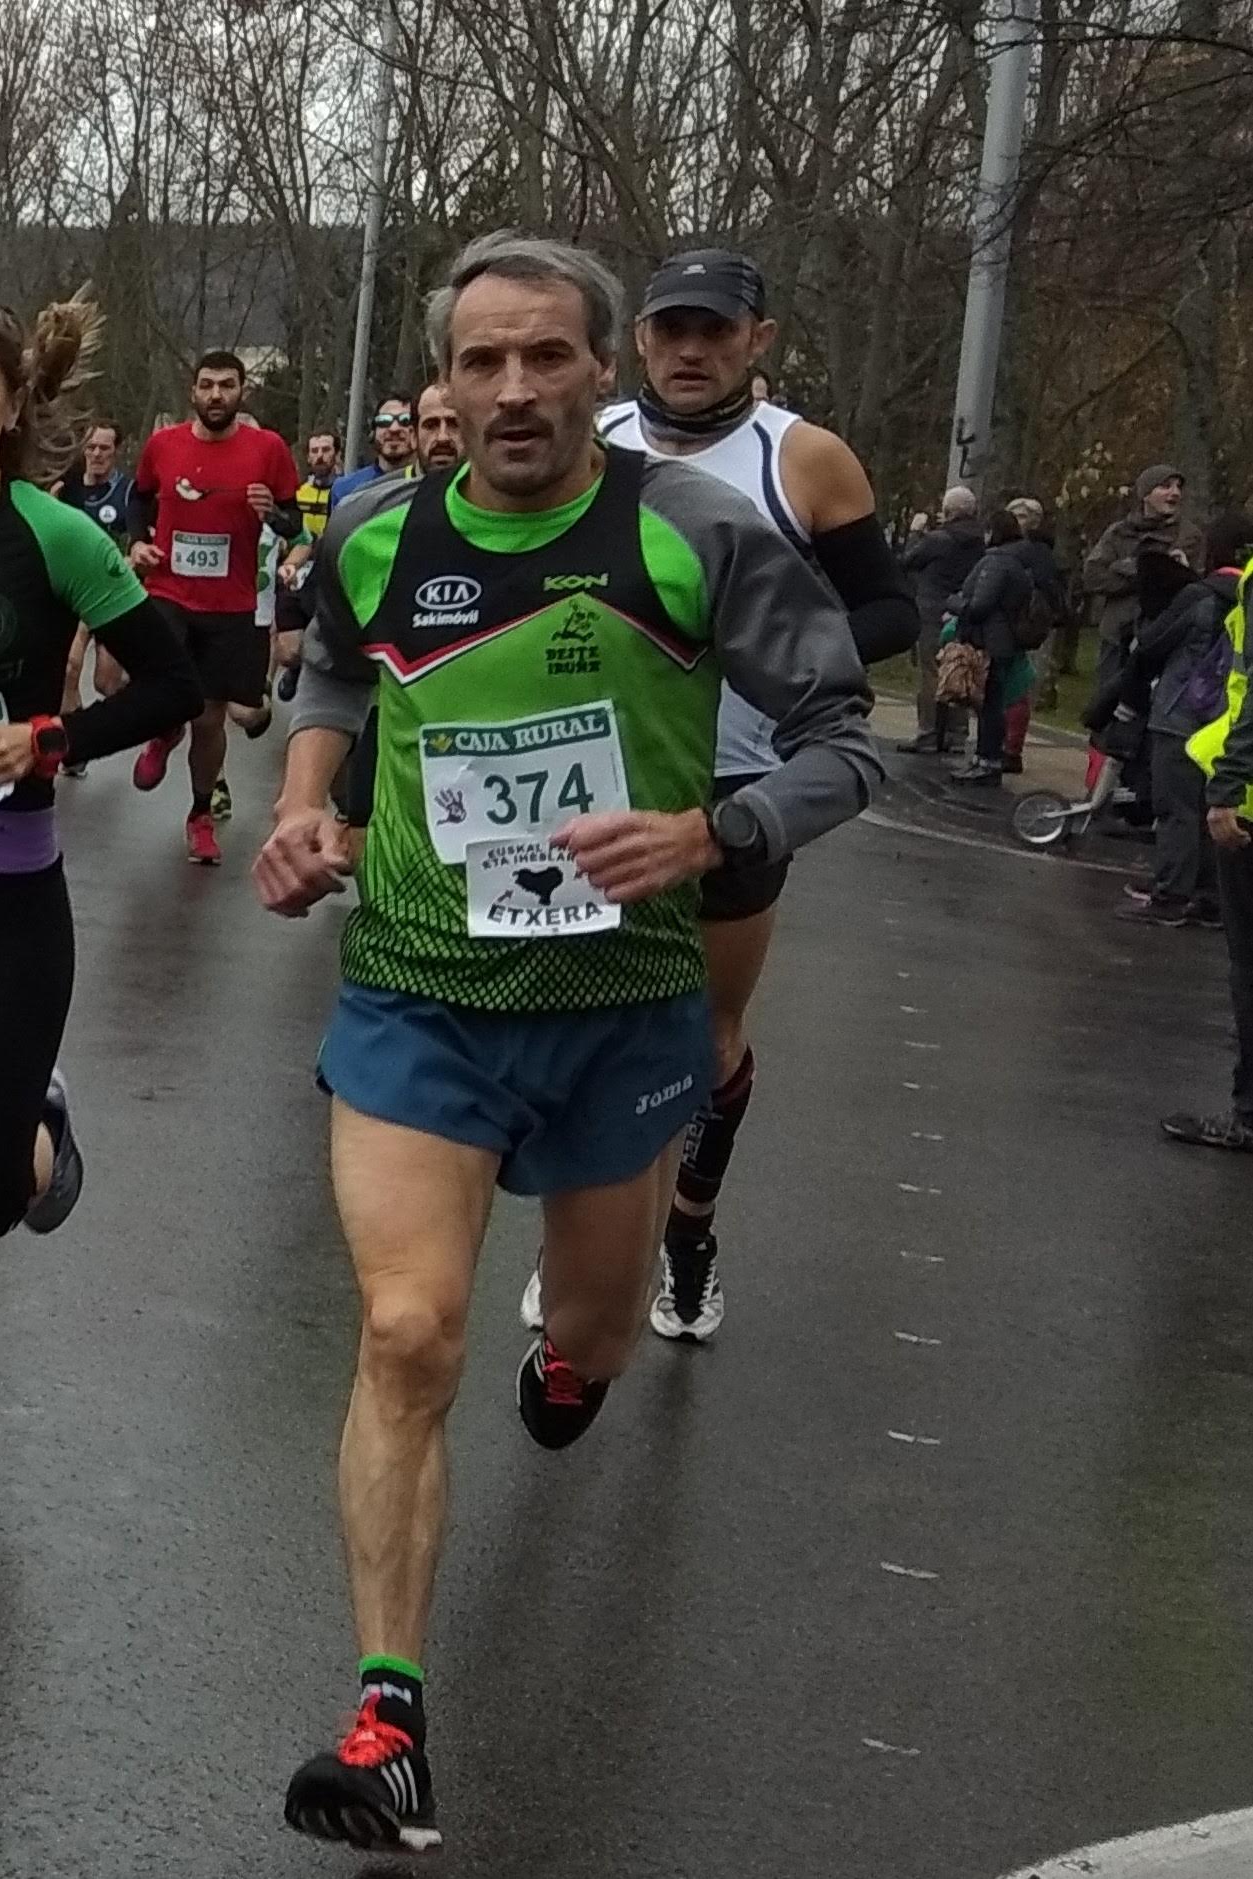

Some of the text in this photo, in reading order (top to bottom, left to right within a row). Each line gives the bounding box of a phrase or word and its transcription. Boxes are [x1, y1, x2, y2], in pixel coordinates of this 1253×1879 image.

[186, 550, 219, 568] 493
[425, 583, 469, 604] KIA
[454, 713, 605, 752] CAJA RURAL
[483, 761, 595, 825] 374
[487, 901, 604, 927] ETXERA
[635, 1073, 693, 1115] Joma
